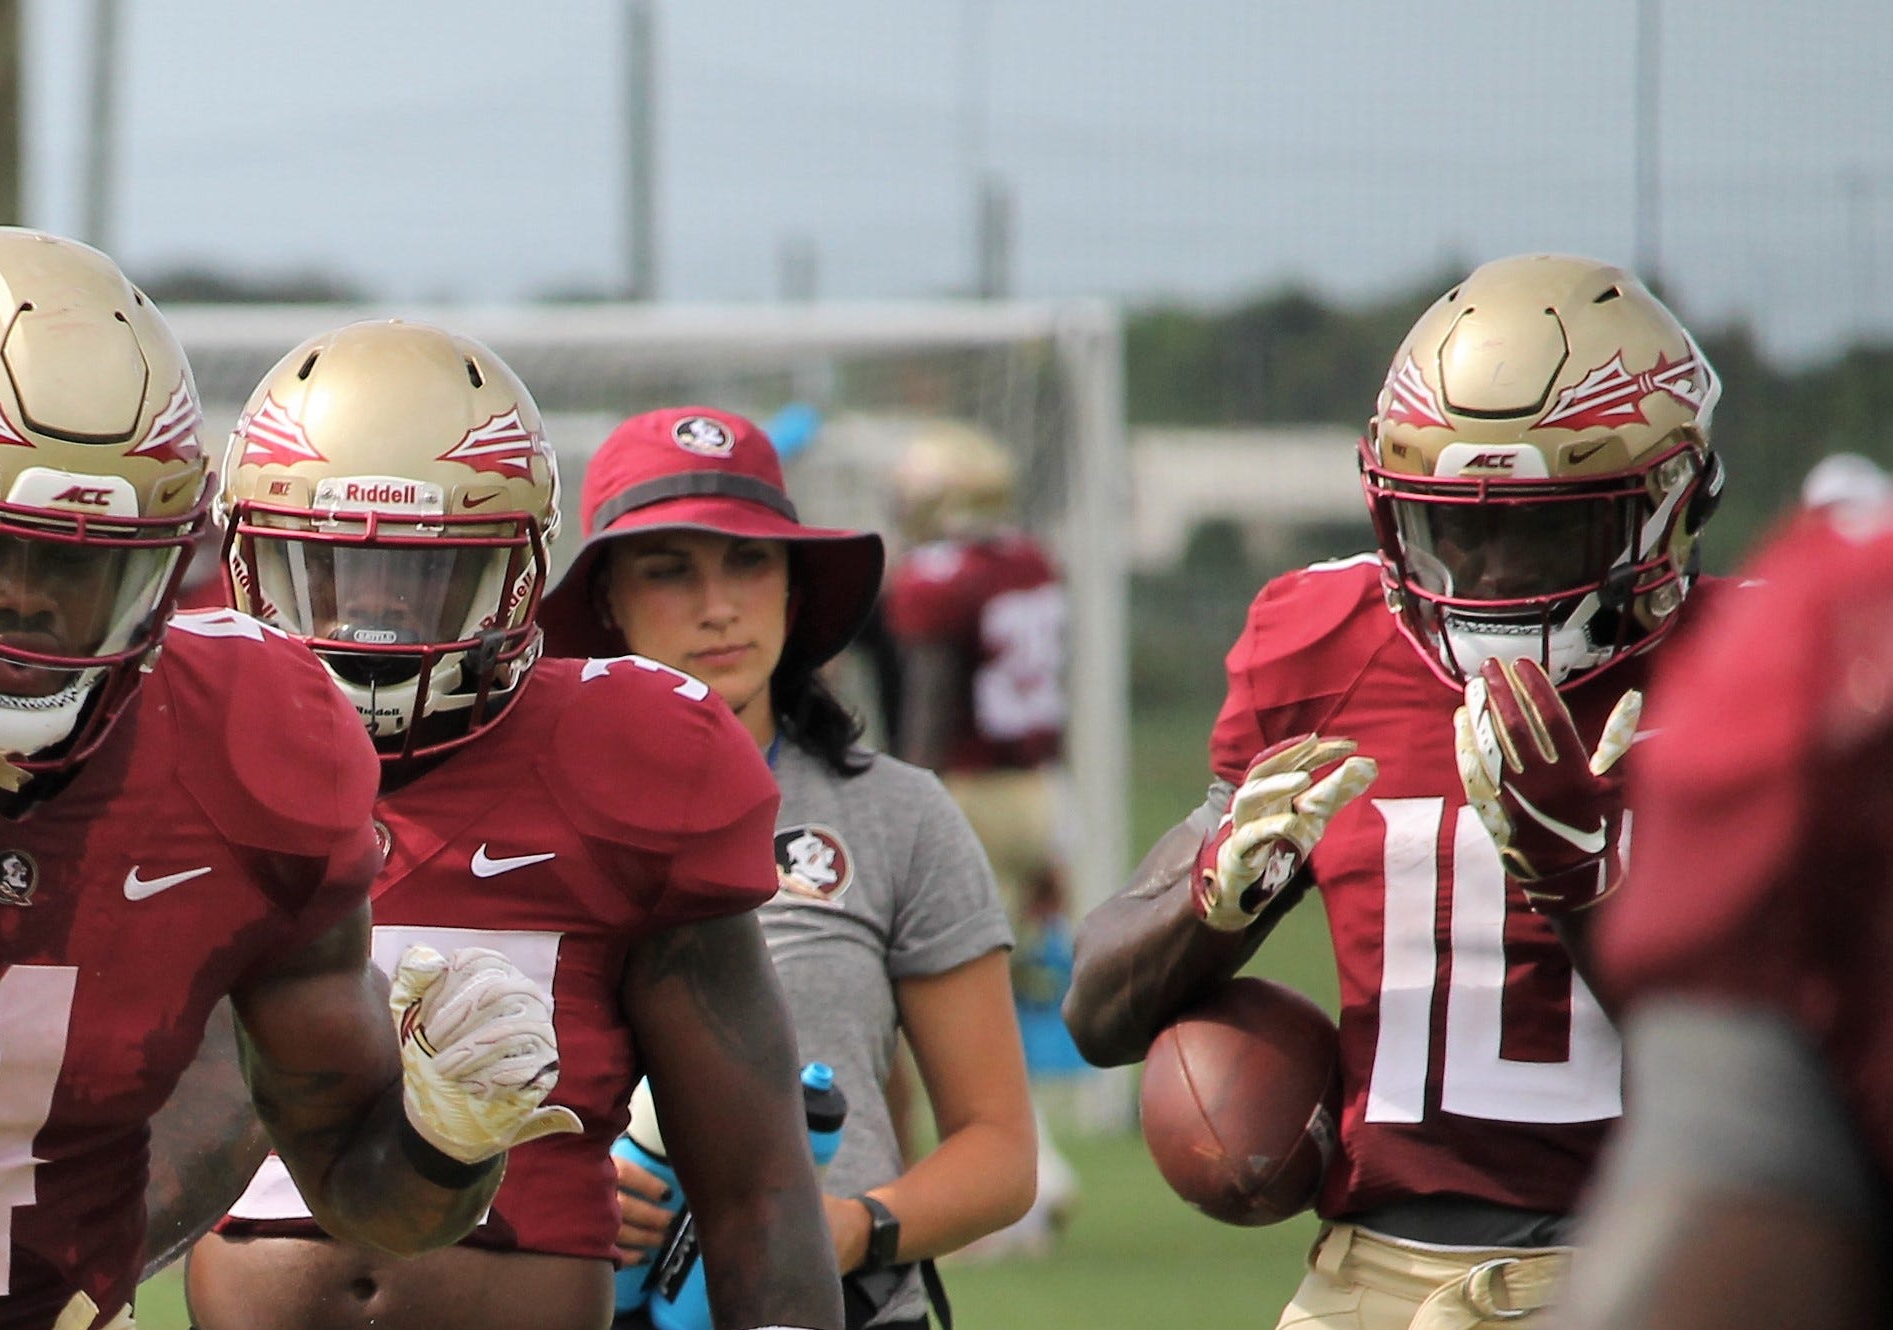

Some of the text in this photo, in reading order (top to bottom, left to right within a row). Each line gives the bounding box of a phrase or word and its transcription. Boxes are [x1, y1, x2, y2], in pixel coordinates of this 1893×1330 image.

[1464, 452, 1518, 468] ACC
[51, 486, 114, 506] ACC
[269, 481, 292, 496] NIKE
[346, 484, 416, 504] Riddell
[1365, 796, 1632, 1124] 10
